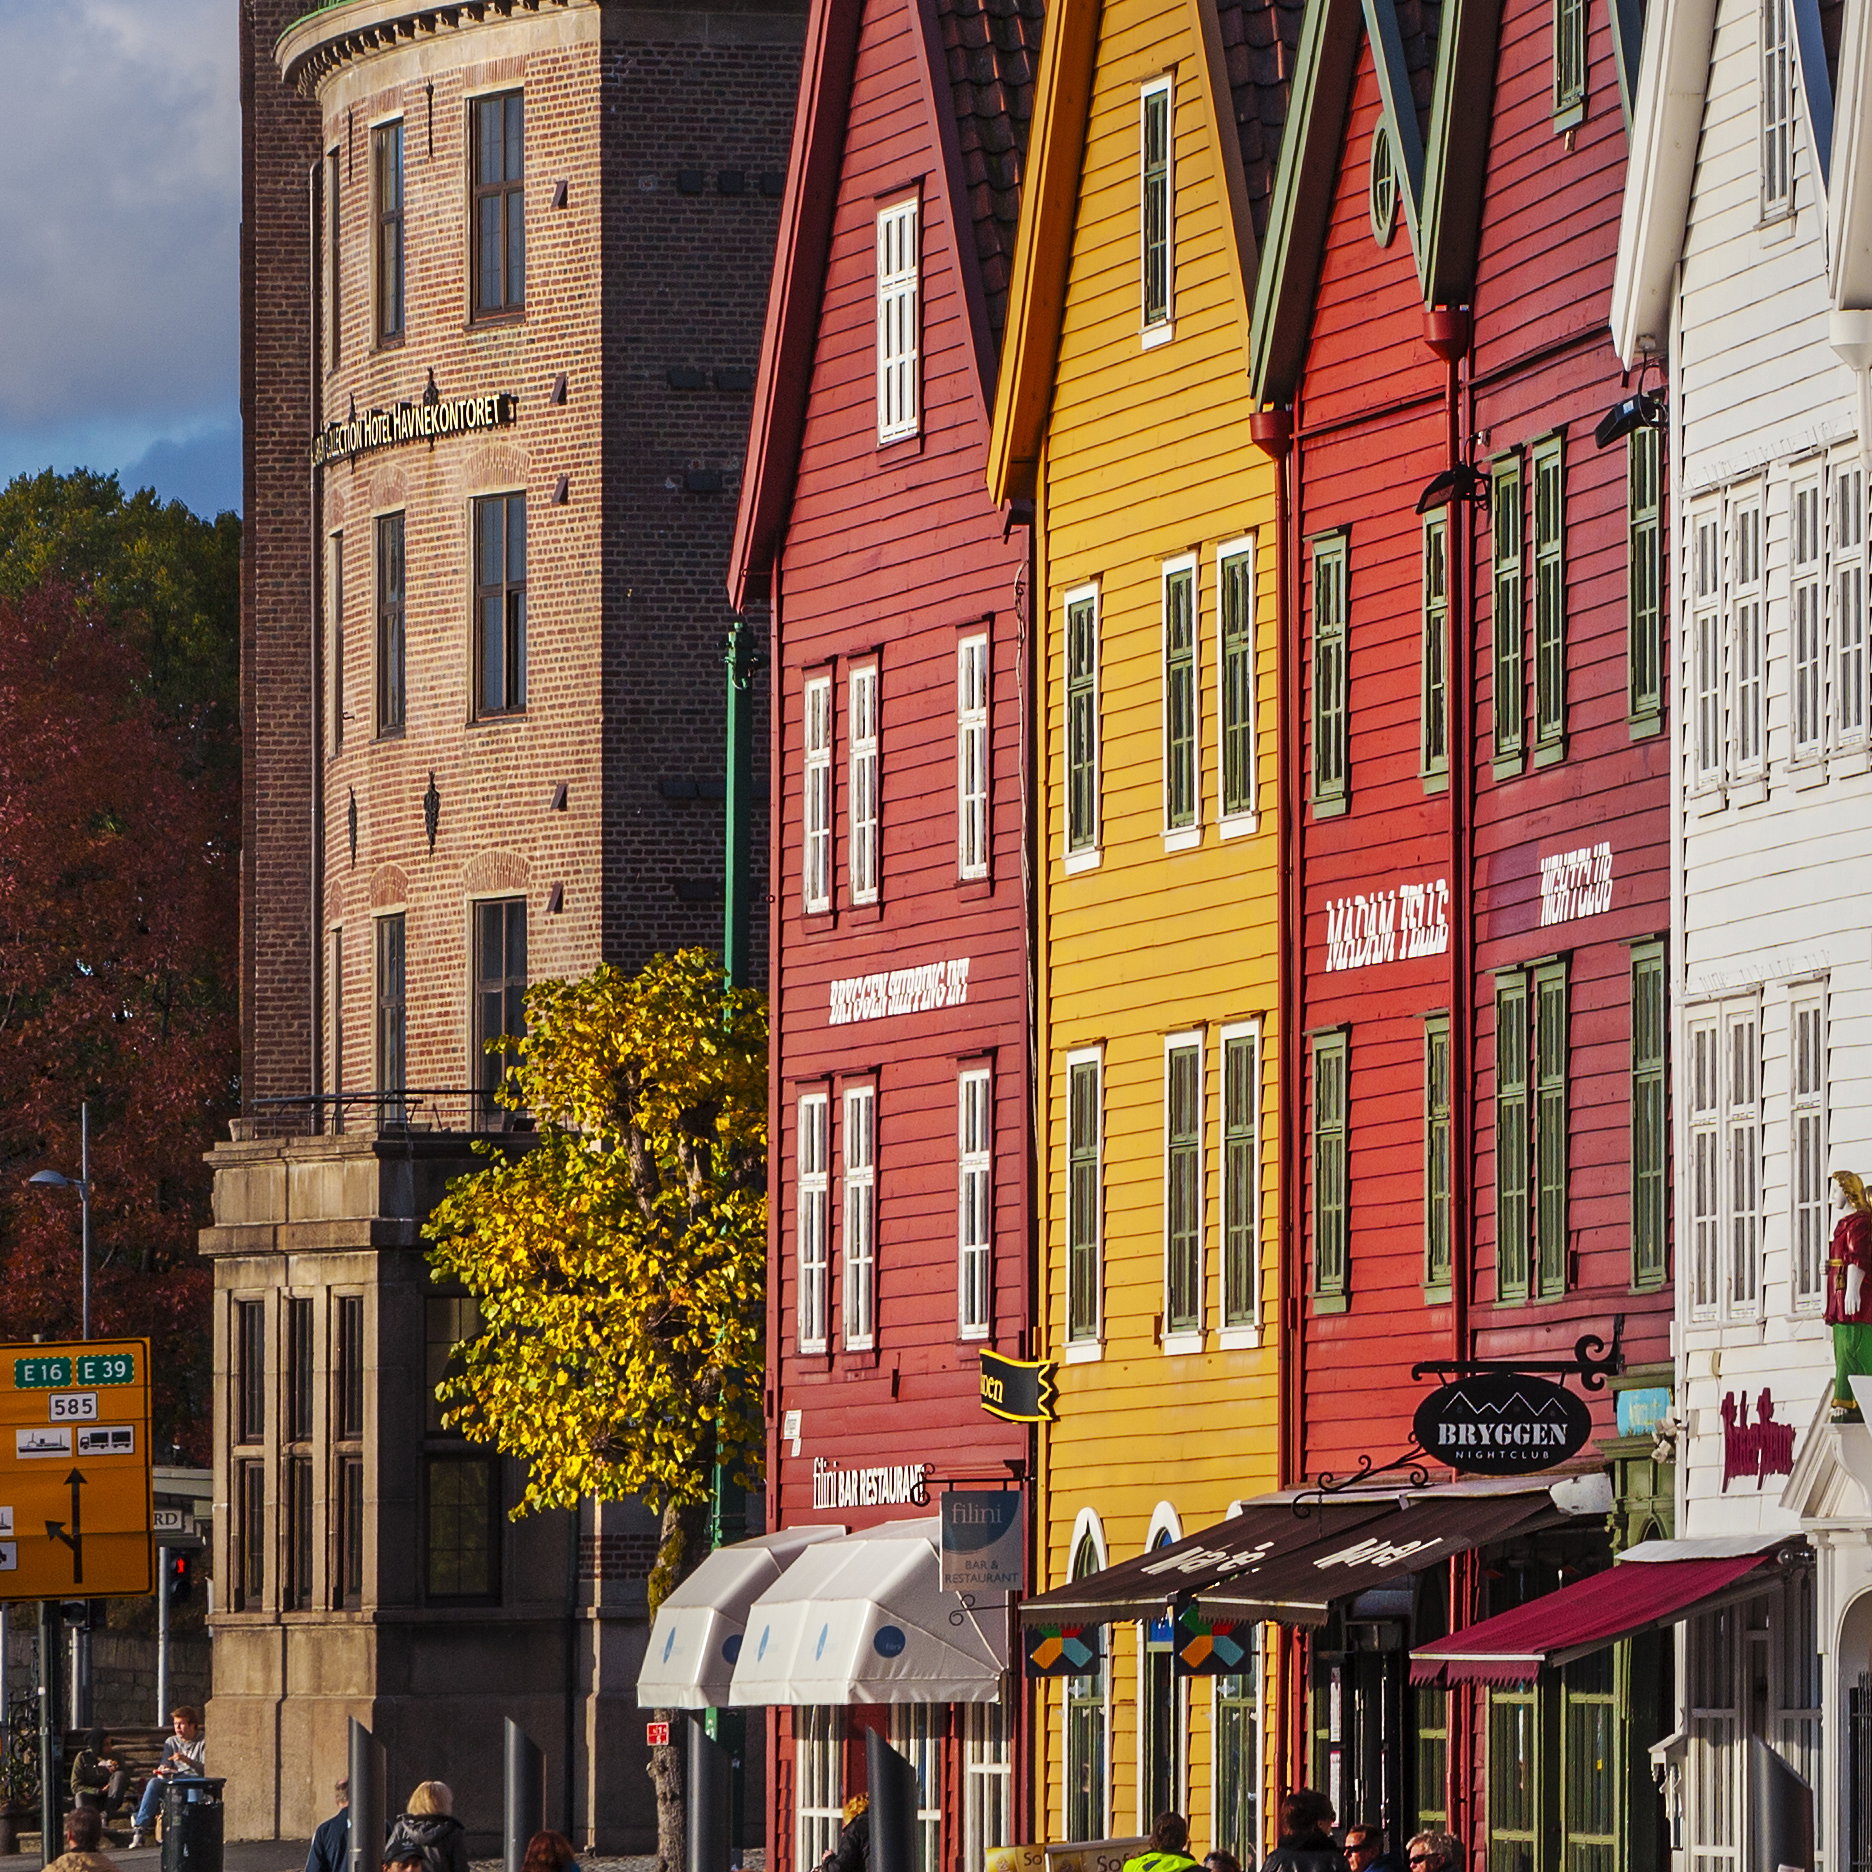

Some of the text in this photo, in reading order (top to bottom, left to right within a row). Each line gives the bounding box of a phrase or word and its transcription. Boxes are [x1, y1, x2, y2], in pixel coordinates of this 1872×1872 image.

[1325, 878, 1449, 973] MADAM FELLE
[24, 1364, 62, 1382] E 16
[84, 1361, 126, 1379] E 39
[54, 1397, 94, 1417] 585
[1437, 1422, 1568, 1446] BRYGGEN
[1455, 1450, 1549, 1460] NIGHTCLUB
[838, 1470, 858, 1507] BAR
[860, 1463, 925, 1506] RESTAURANT
[952, 1502, 1003, 1524] filini
[965, 1560, 987, 1570] BAR
[944, 1572, 1018, 1584] RESTAURANT
